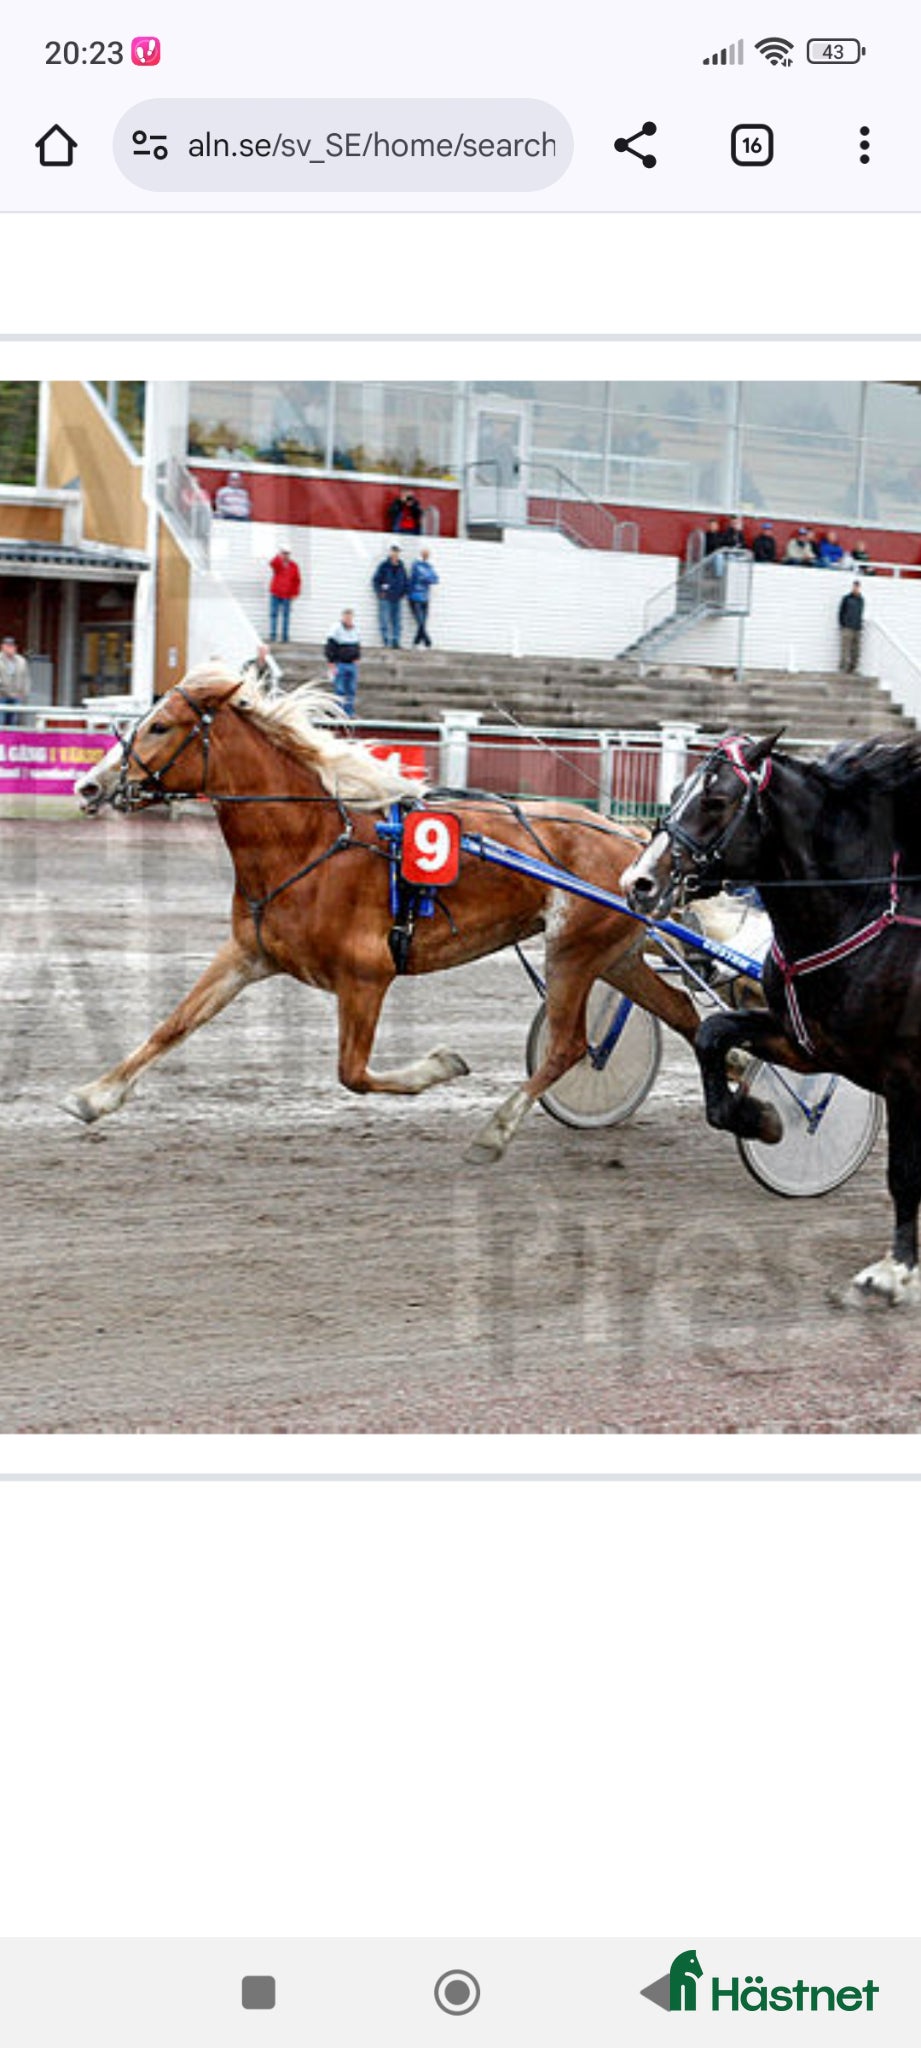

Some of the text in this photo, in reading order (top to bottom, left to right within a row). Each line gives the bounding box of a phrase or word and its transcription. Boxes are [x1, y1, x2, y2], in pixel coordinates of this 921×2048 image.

[45, 41, 124, 65] 20:23
[822, 44, 844, 60] 43
[188, 131, 556, 163] aln.se/sv_SE/home/search
[742, 138, 763, 154] 16
[414, 818, 451, 872] 9
